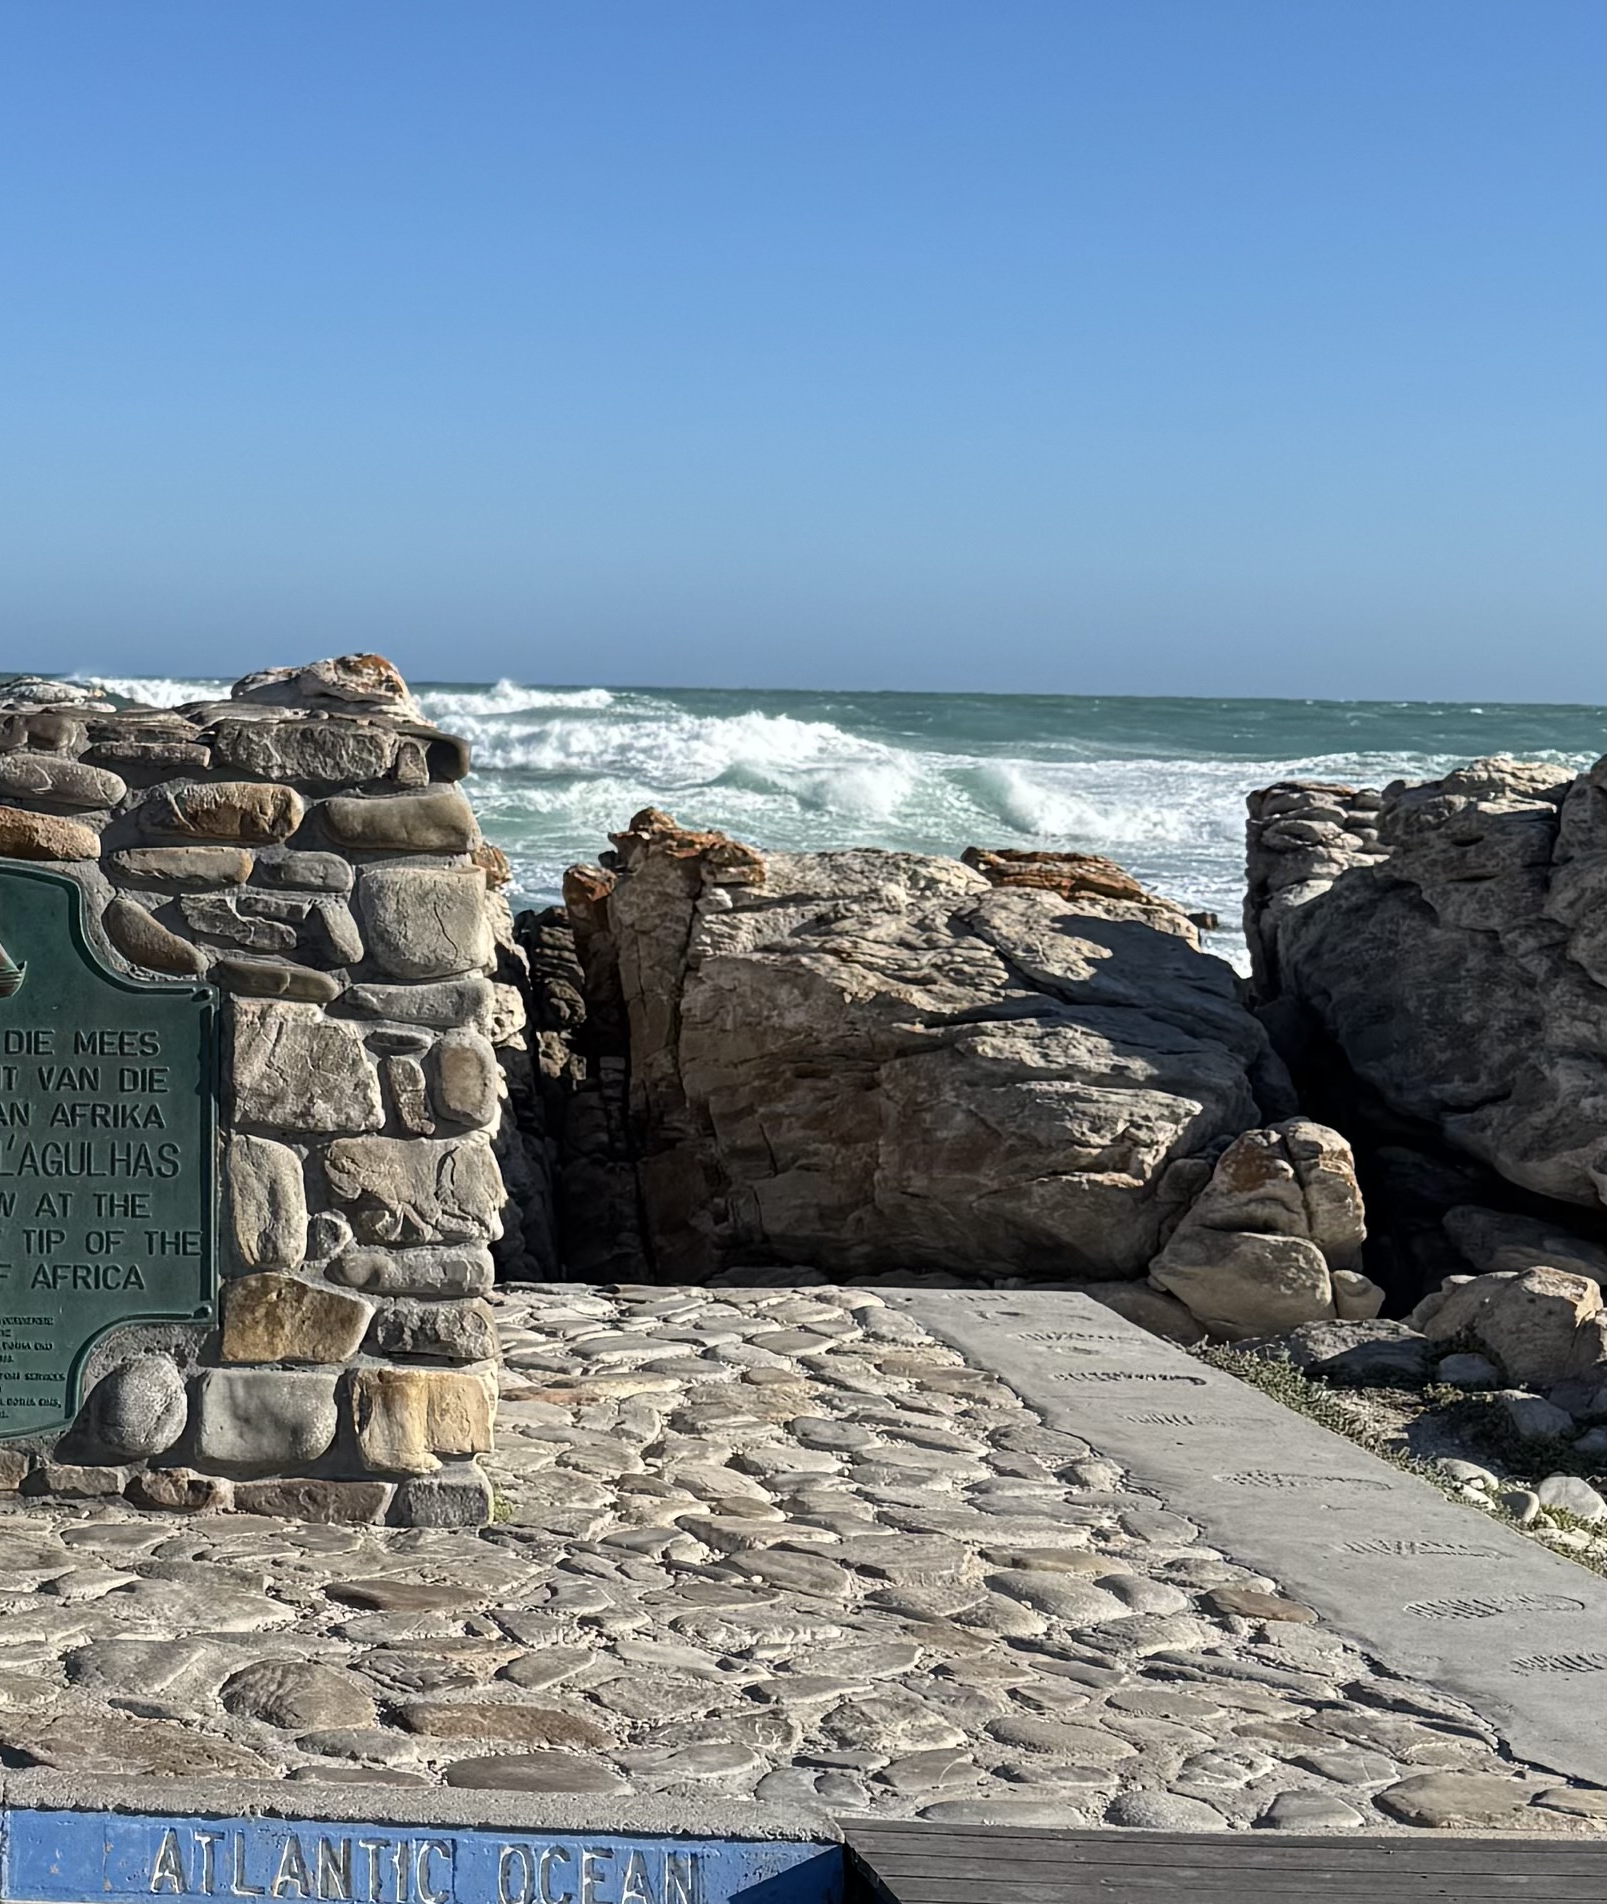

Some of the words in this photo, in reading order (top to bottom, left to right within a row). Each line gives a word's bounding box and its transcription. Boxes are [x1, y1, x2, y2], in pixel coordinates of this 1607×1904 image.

[4, 1029, 55, 1056] DIE
[74, 1030, 161, 1058] MEES
[38, 1065, 100, 1091] VAN
[119, 1067, 170, 1093] DIE
[49, 1102, 167, 1130] AFRIKA
[35, 1192, 74, 1218] AT
[93, 1193, 152, 1219] THE
[22, 1229, 67, 1256] TIP
[85, 1230, 126, 1256] OF
[144, 1231, 203, 1257] THE
[30, 1264, 146, 1291] AFRICA
